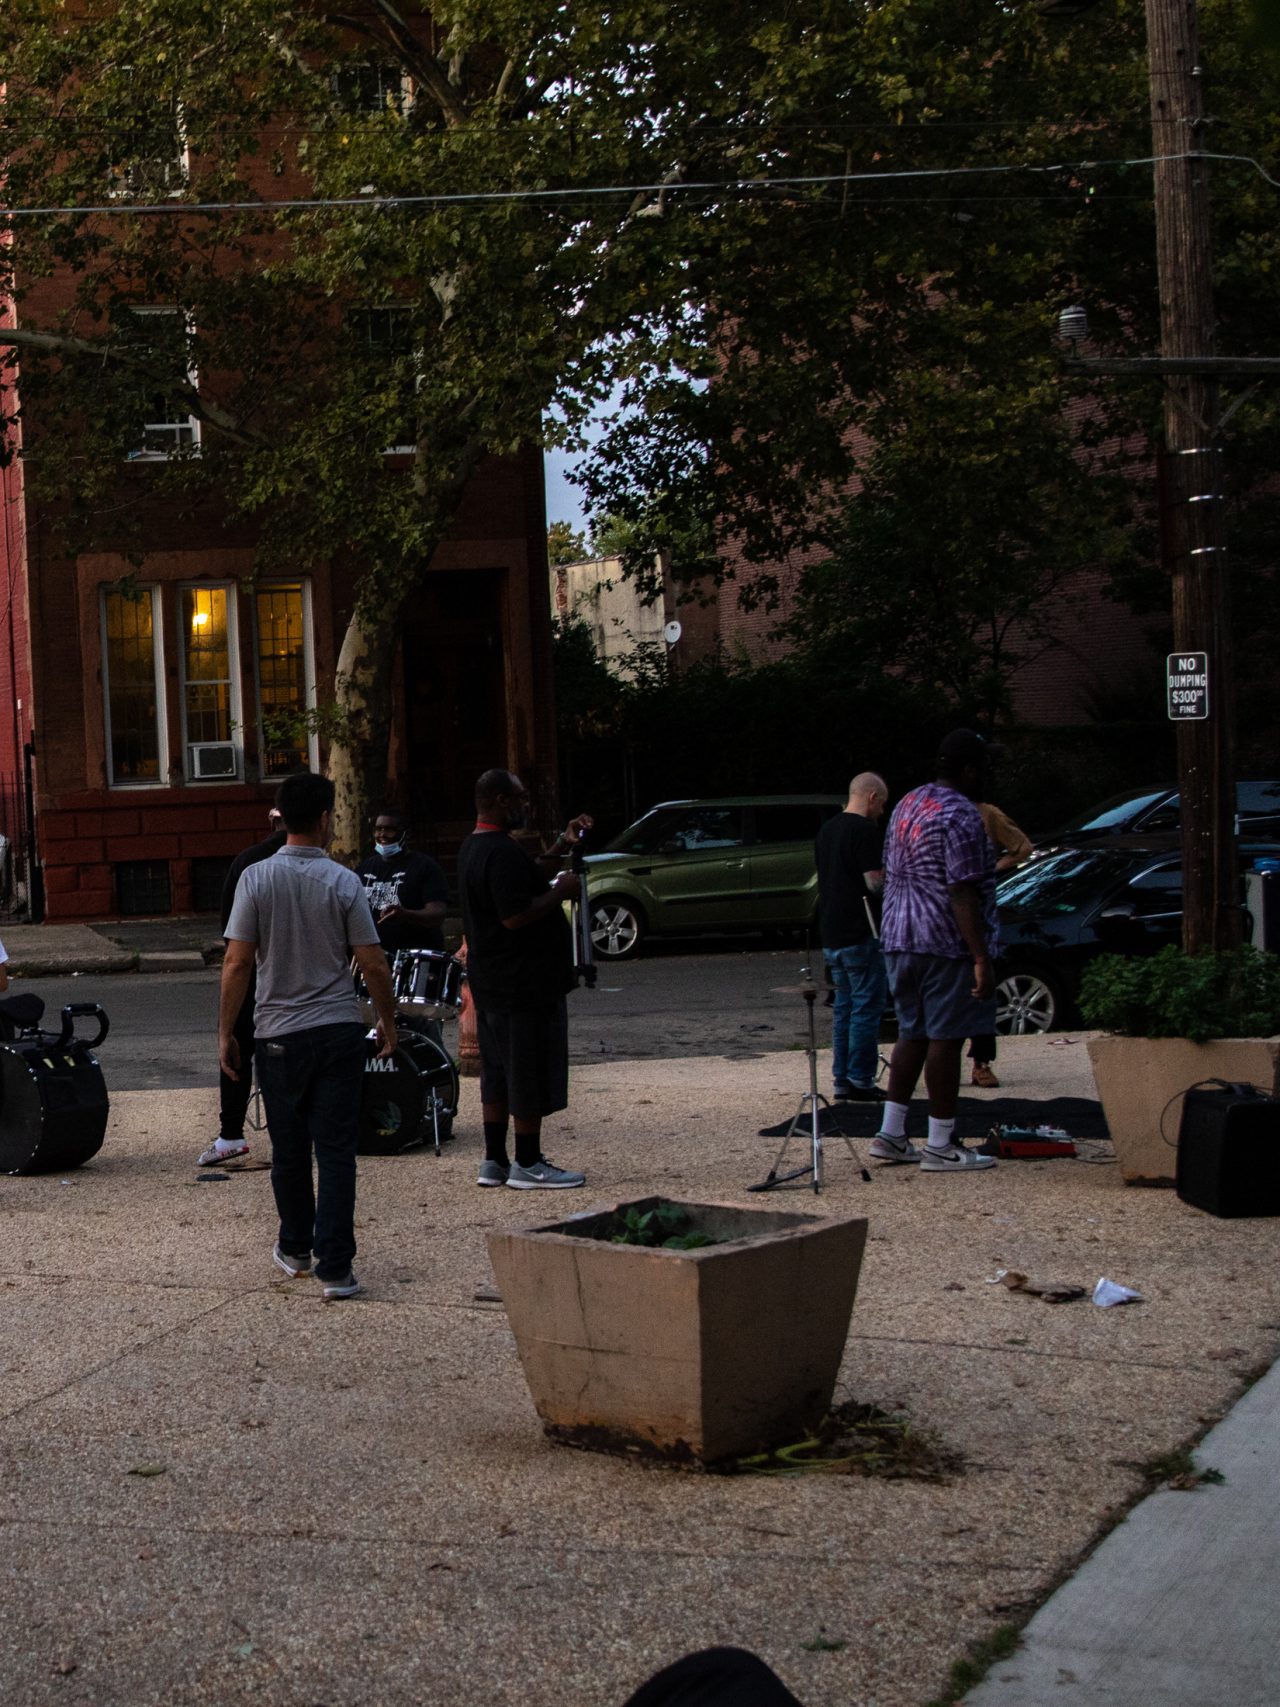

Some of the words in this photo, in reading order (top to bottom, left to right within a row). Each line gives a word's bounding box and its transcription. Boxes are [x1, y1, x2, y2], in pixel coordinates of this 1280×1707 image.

[1178, 657, 1196, 672] NO
[1169, 673, 1206, 688] DUMPING
[1179, 705, 1197, 714] FINE
